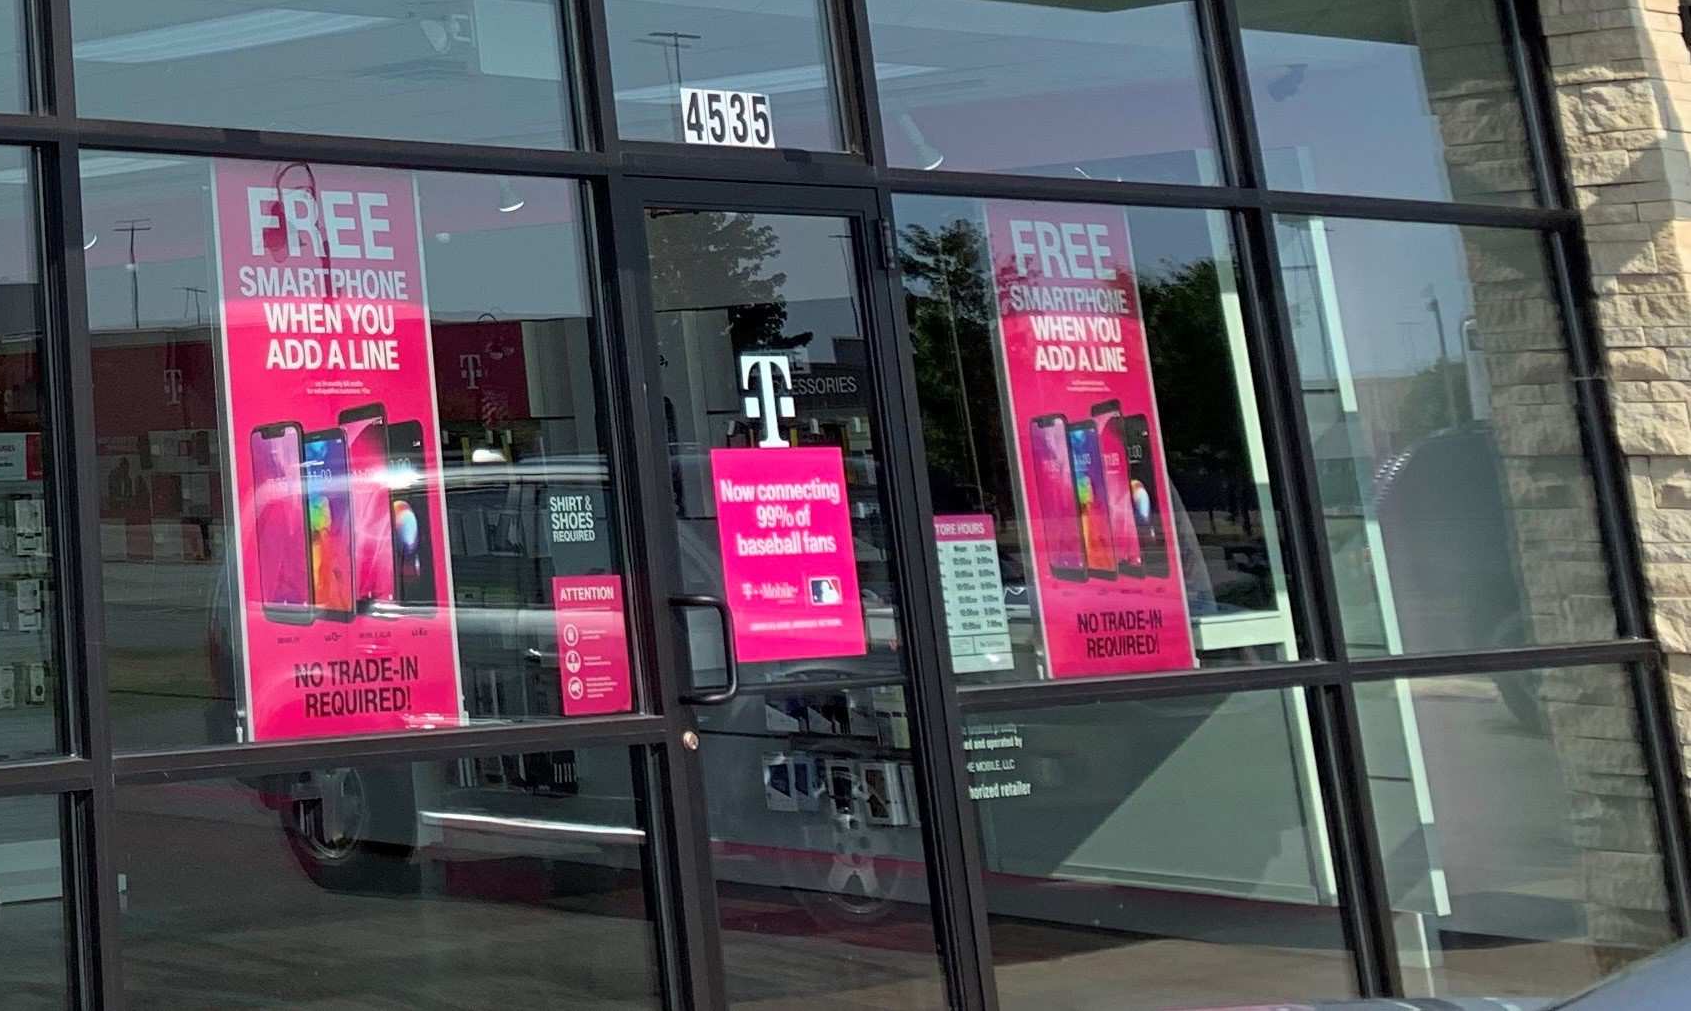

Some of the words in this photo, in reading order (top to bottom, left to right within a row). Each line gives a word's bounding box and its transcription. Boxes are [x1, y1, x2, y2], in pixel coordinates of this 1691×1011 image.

[686, 92, 771, 145] 4535
[246, 186, 395, 260] FREE
[1010, 219, 1117, 280] FREE
[238, 265, 408, 300] SMARTPHONE
[1009, 283, 1130, 314] SMARTPHONE
[263, 302, 343, 334] WHEN
[346, 303, 396, 335] YOU
[1029, 315, 1089, 342] WHEN
[1089, 316, 1122, 343] YOU
[265, 339, 323, 370] ADD
[327, 339, 346, 370] A
[348, 339, 401, 371] LINE
[1034, 344, 1076, 372] ADD
[1078, 345, 1093, 372] A
[1094, 345, 1128, 373] LINE
[549, 495, 583, 512] SHIRT
[585, 495, 593, 511] &
[720, 479, 755, 503] Now
[758, 477, 841, 505] connecting
[552, 512, 595, 530] SHOES
[756, 505, 793, 529] 99%
[795, 504, 812, 528] of
[934, 523, 956, 536] TORE
[958, 522, 985, 535] HOURS
[553, 529, 596, 543] REQUIRED
[736, 531, 802, 557] baseball
[803, 532, 837, 554] fans
[560, 586, 614, 602] ATTENTION
[1077, 612, 1099, 634] NO
[1100, 609, 1163, 631] TRADE-IN
[1086, 634, 1160, 659] REQUIRED!
[294, 661, 324, 688] NO
[328, 655, 419, 686] TRADE-IN
[305, 686, 412, 718] REQUIRED!
[968, 782, 1000, 800] horized
[1000, 780, 1031, 797] retailer
